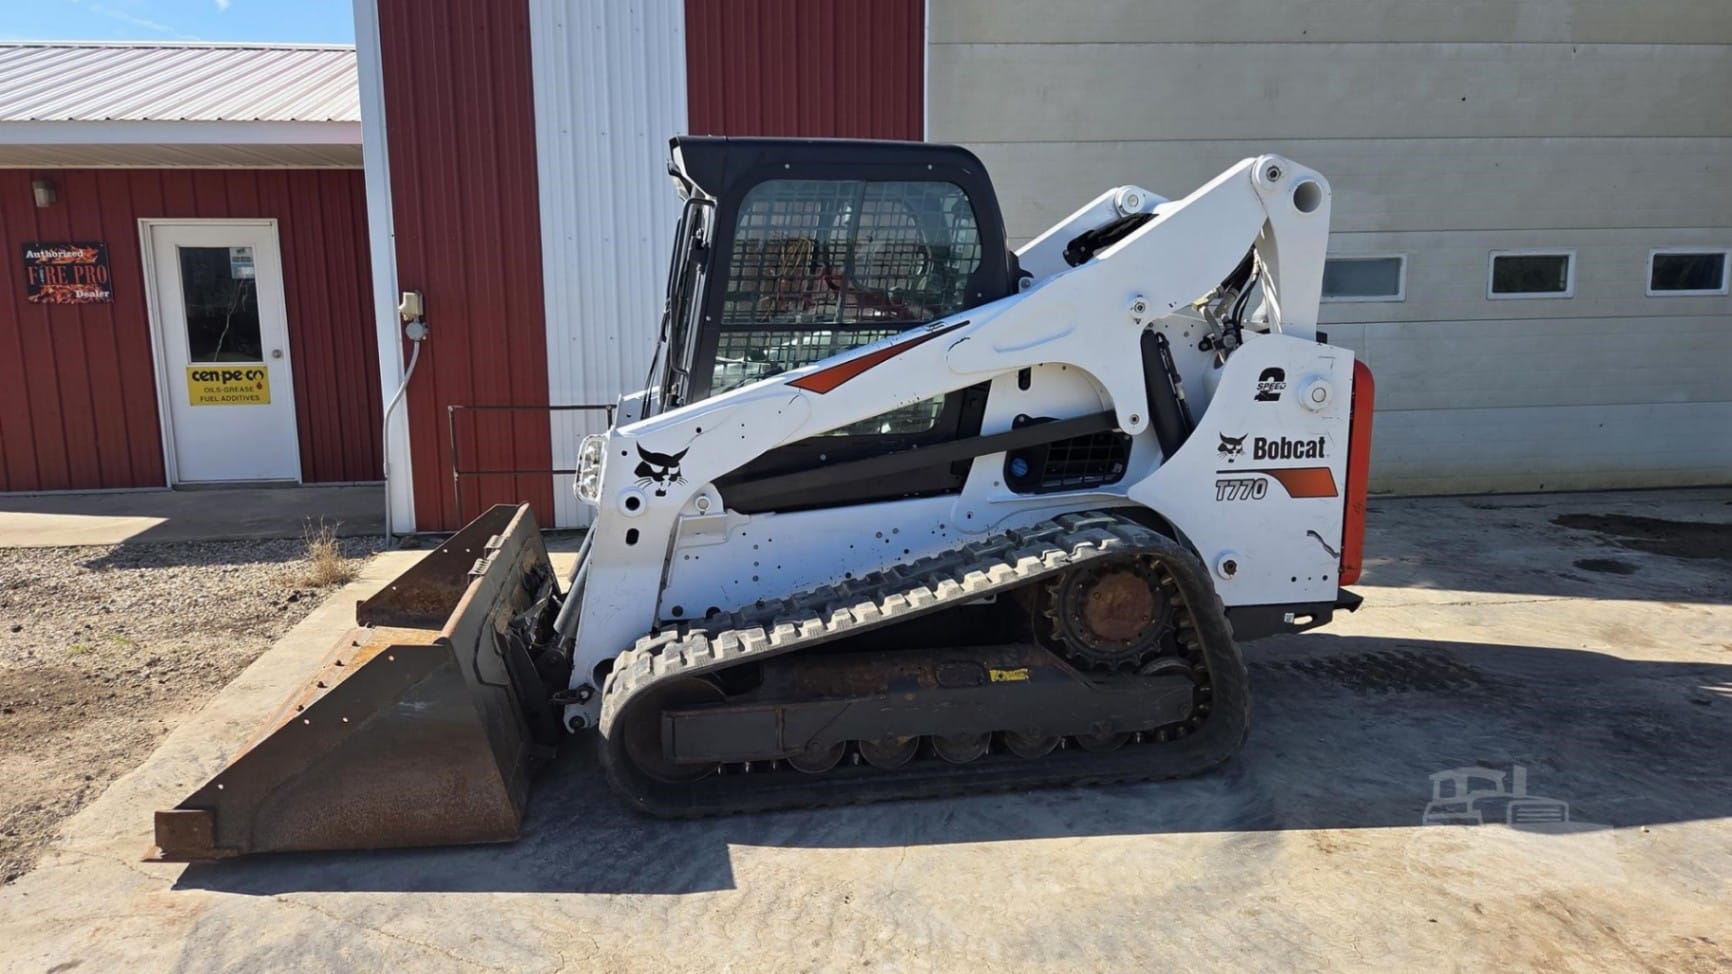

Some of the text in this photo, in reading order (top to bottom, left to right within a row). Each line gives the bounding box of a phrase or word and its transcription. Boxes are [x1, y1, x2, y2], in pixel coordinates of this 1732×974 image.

[26, 248, 84, 258] Authorized
[74, 264, 108, 285] PRO
[75, 289, 110, 298] Dealer
[1256, 382, 1287, 391] SPEED
[221, 394, 260, 402] ADDITIVES
[1253, 436, 1326, 460] Bobcat
[1216, 478, 1268, 501] T770
